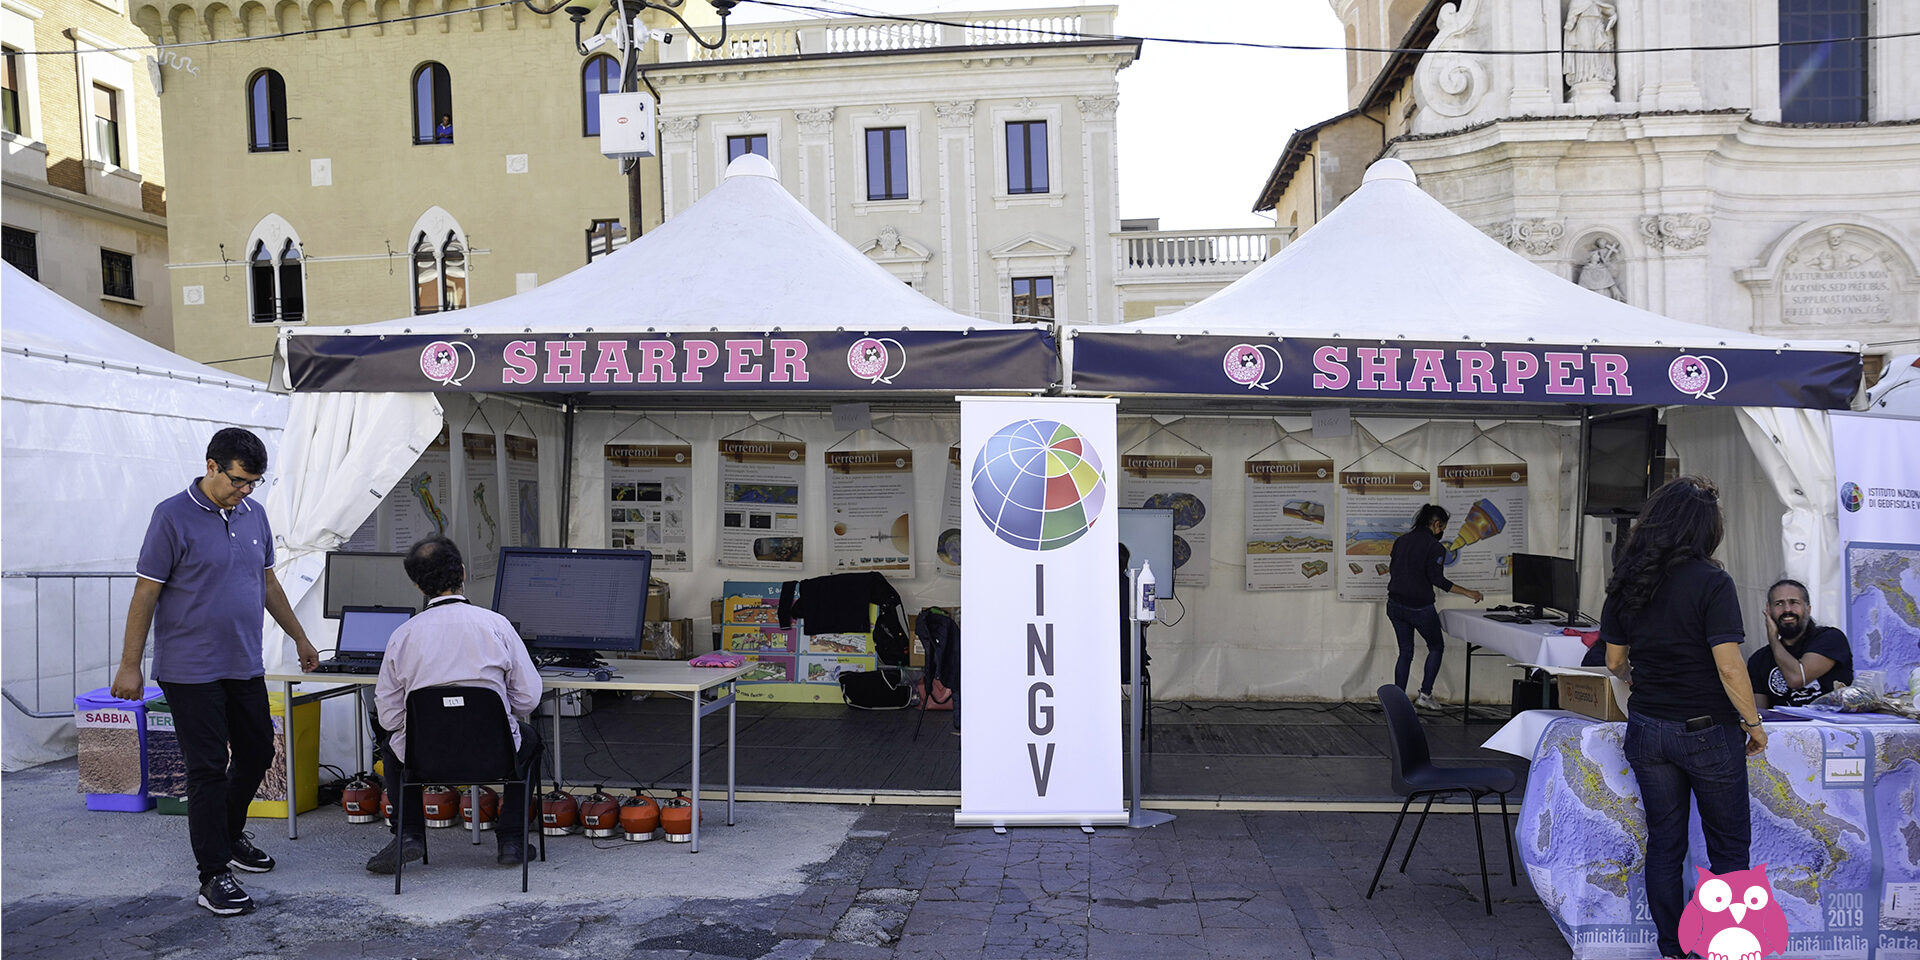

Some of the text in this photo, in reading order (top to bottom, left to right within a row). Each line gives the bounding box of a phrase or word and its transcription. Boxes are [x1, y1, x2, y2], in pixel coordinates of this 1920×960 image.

[1868, 271, 1888, 279] NON
[1829, 282, 1847, 292] SED
[502, 340, 809, 384] SHARPER
[1313, 345, 1632, 396] SHARPER
[611, 447, 659, 457] terremoti
[725, 443, 773, 453] terremoti
[831, 452, 879, 464] terremoti
[1128, 457, 1178, 468] terremoti
[1252, 462, 1300, 473] terremoti
[1444, 466, 1494, 477] terremoti
[1346, 474, 1396, 485] terremoti
[1868, 488, 1896, 497] ISTITUTO
[1869, 499, 1876, 507] DI
[1877, 499, 1911, 508] GEOFISICA
[1912, 501, 1916, 509] E
[1027, 564, 1055, 797] INGV
[86, 713, 131, 724] SABBIA
[149, 716, 175, 726] TER
[1828, 893, 1863, 909] 2000
[1635, 903, 1653, 921] 20
[1828, 909, 1863, 927] 2019
[1879, 933, 1918, 950] Carta
